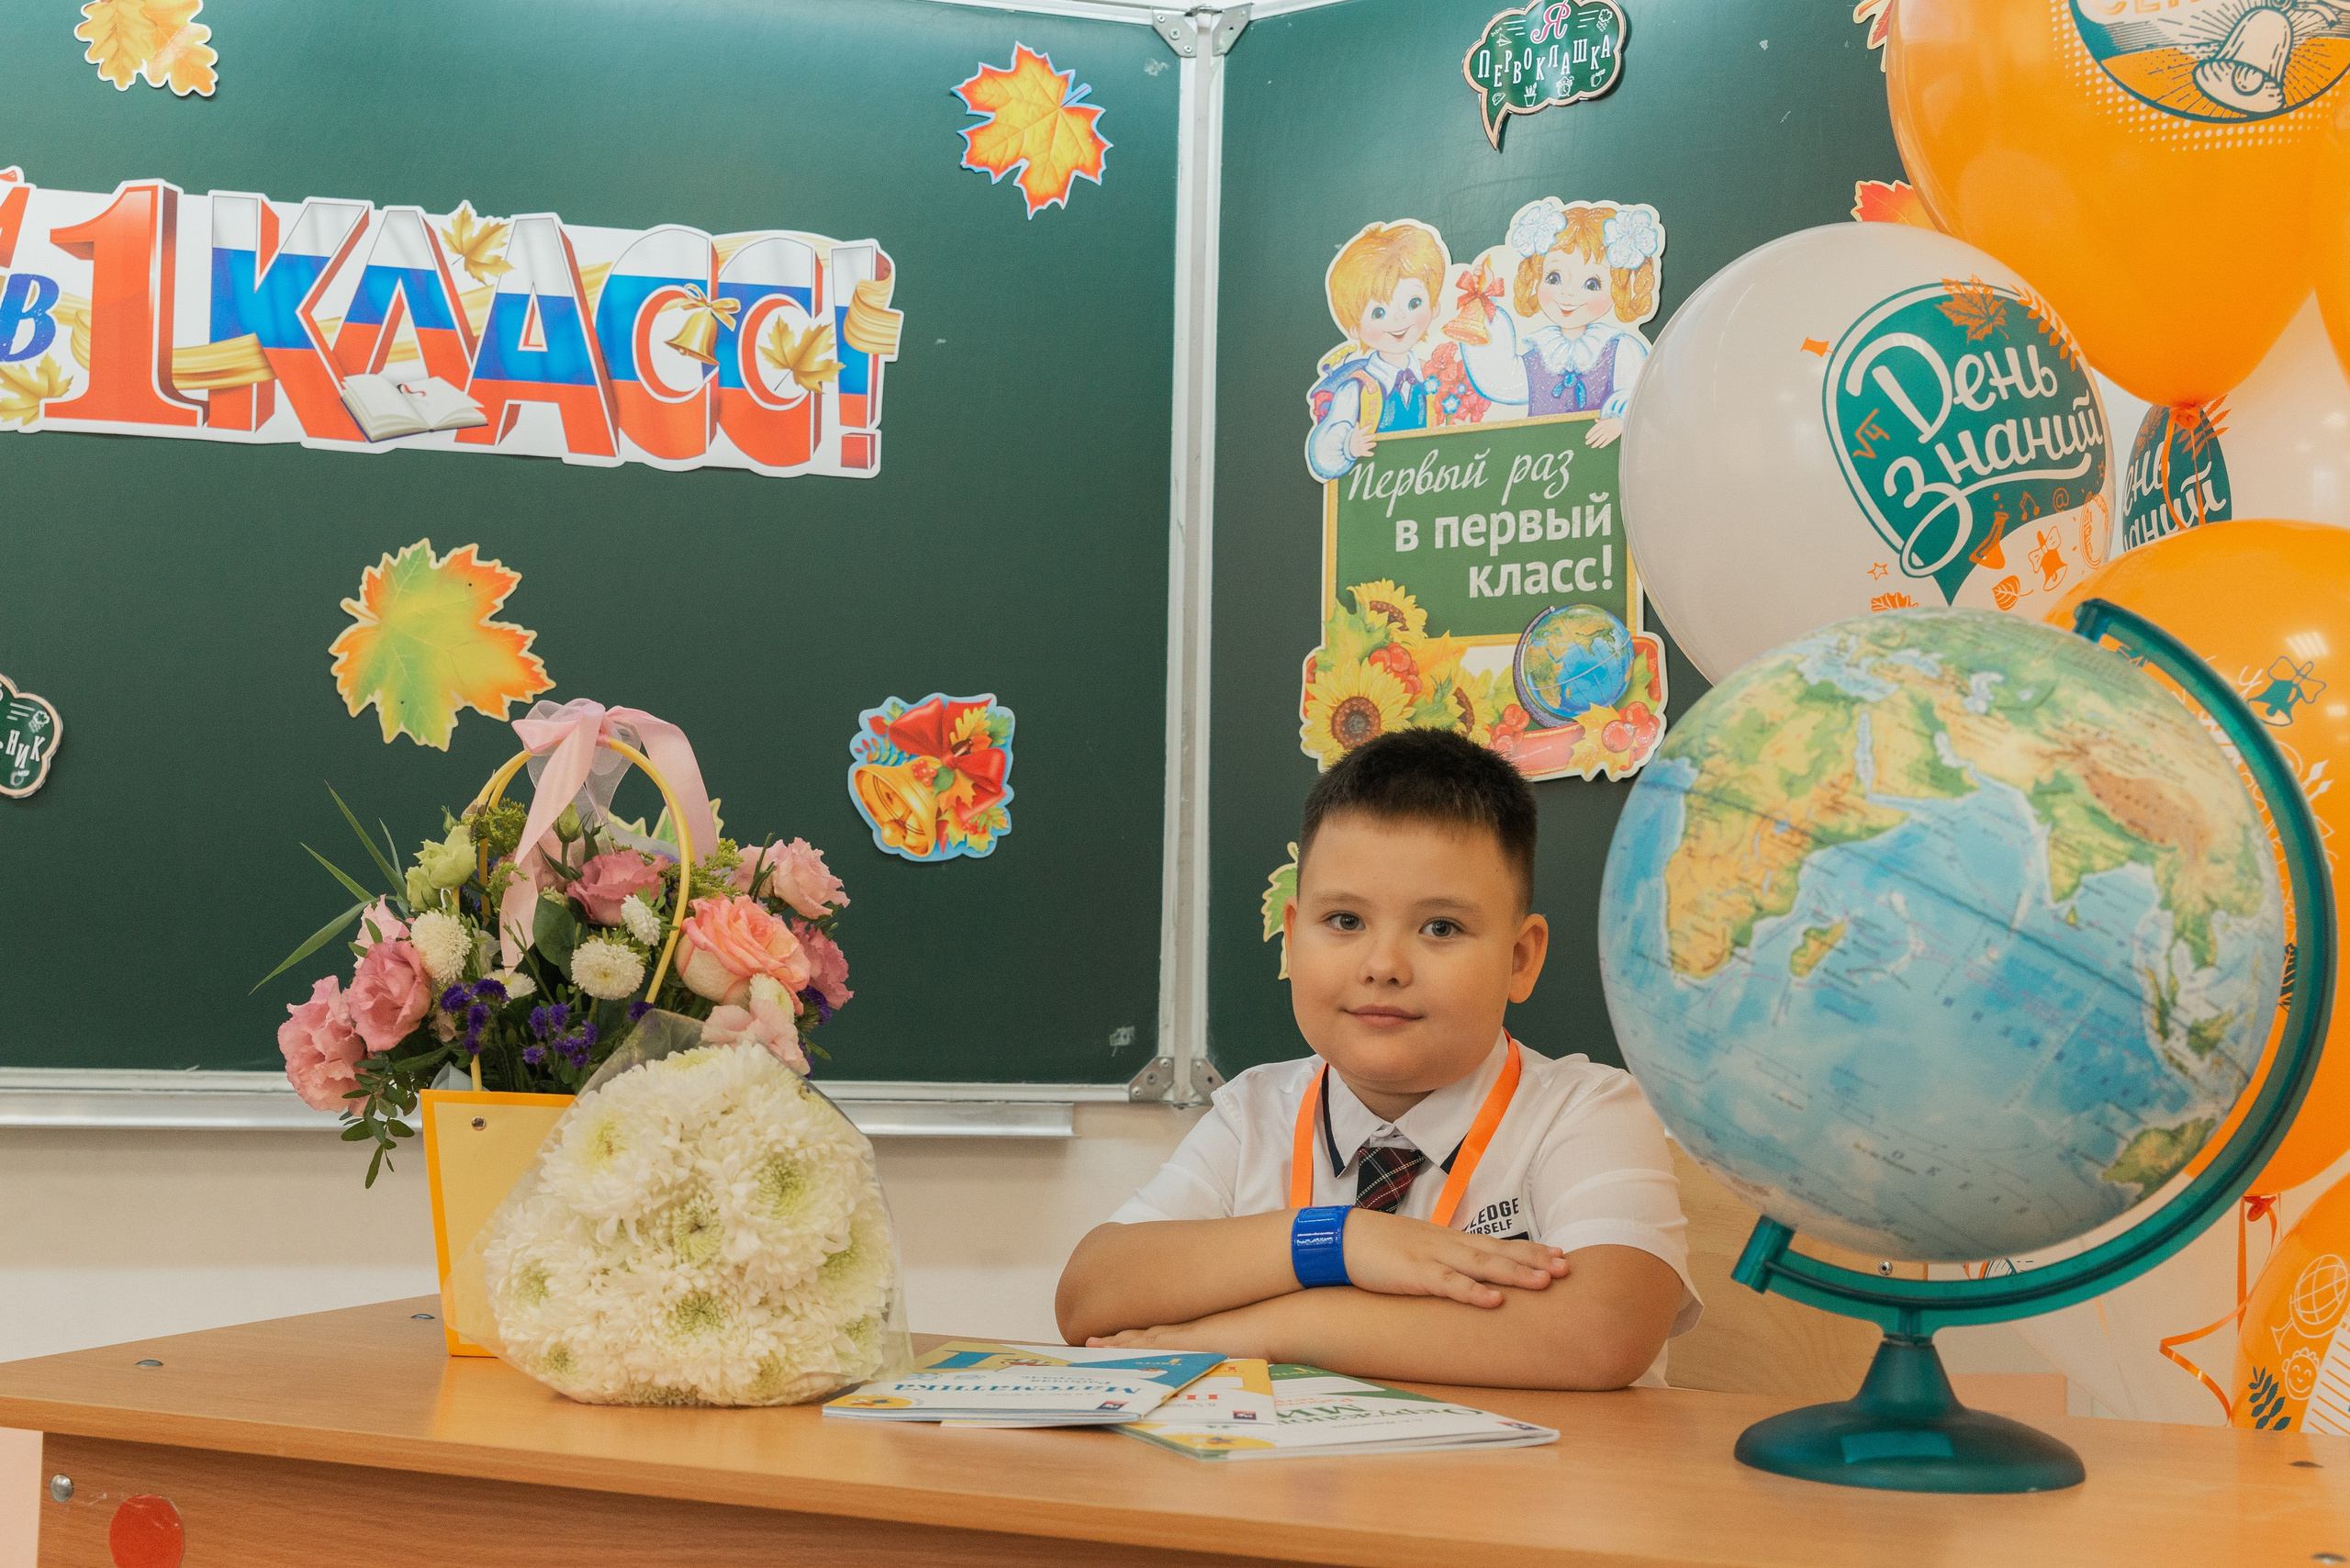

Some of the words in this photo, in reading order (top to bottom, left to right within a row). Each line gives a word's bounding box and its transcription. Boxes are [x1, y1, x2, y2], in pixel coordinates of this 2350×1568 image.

[1530, 1, 1572, 44] Я
[1477, 34, 1611, 88] ПЕРВОКЛАШКА
[1845, 331, 2058, 443] День
[1348, 448, 1492, 518] Первый
[1501, 449, 1575, 506] раз
[1884, 390, 2103, 577] Знаний
[2123, 441, 2171, 517] ень
[1395, 519, 1419, 553] в
[1434, 491, 1612, 556] первый
[1469, 543, 1614, 599] класс!
